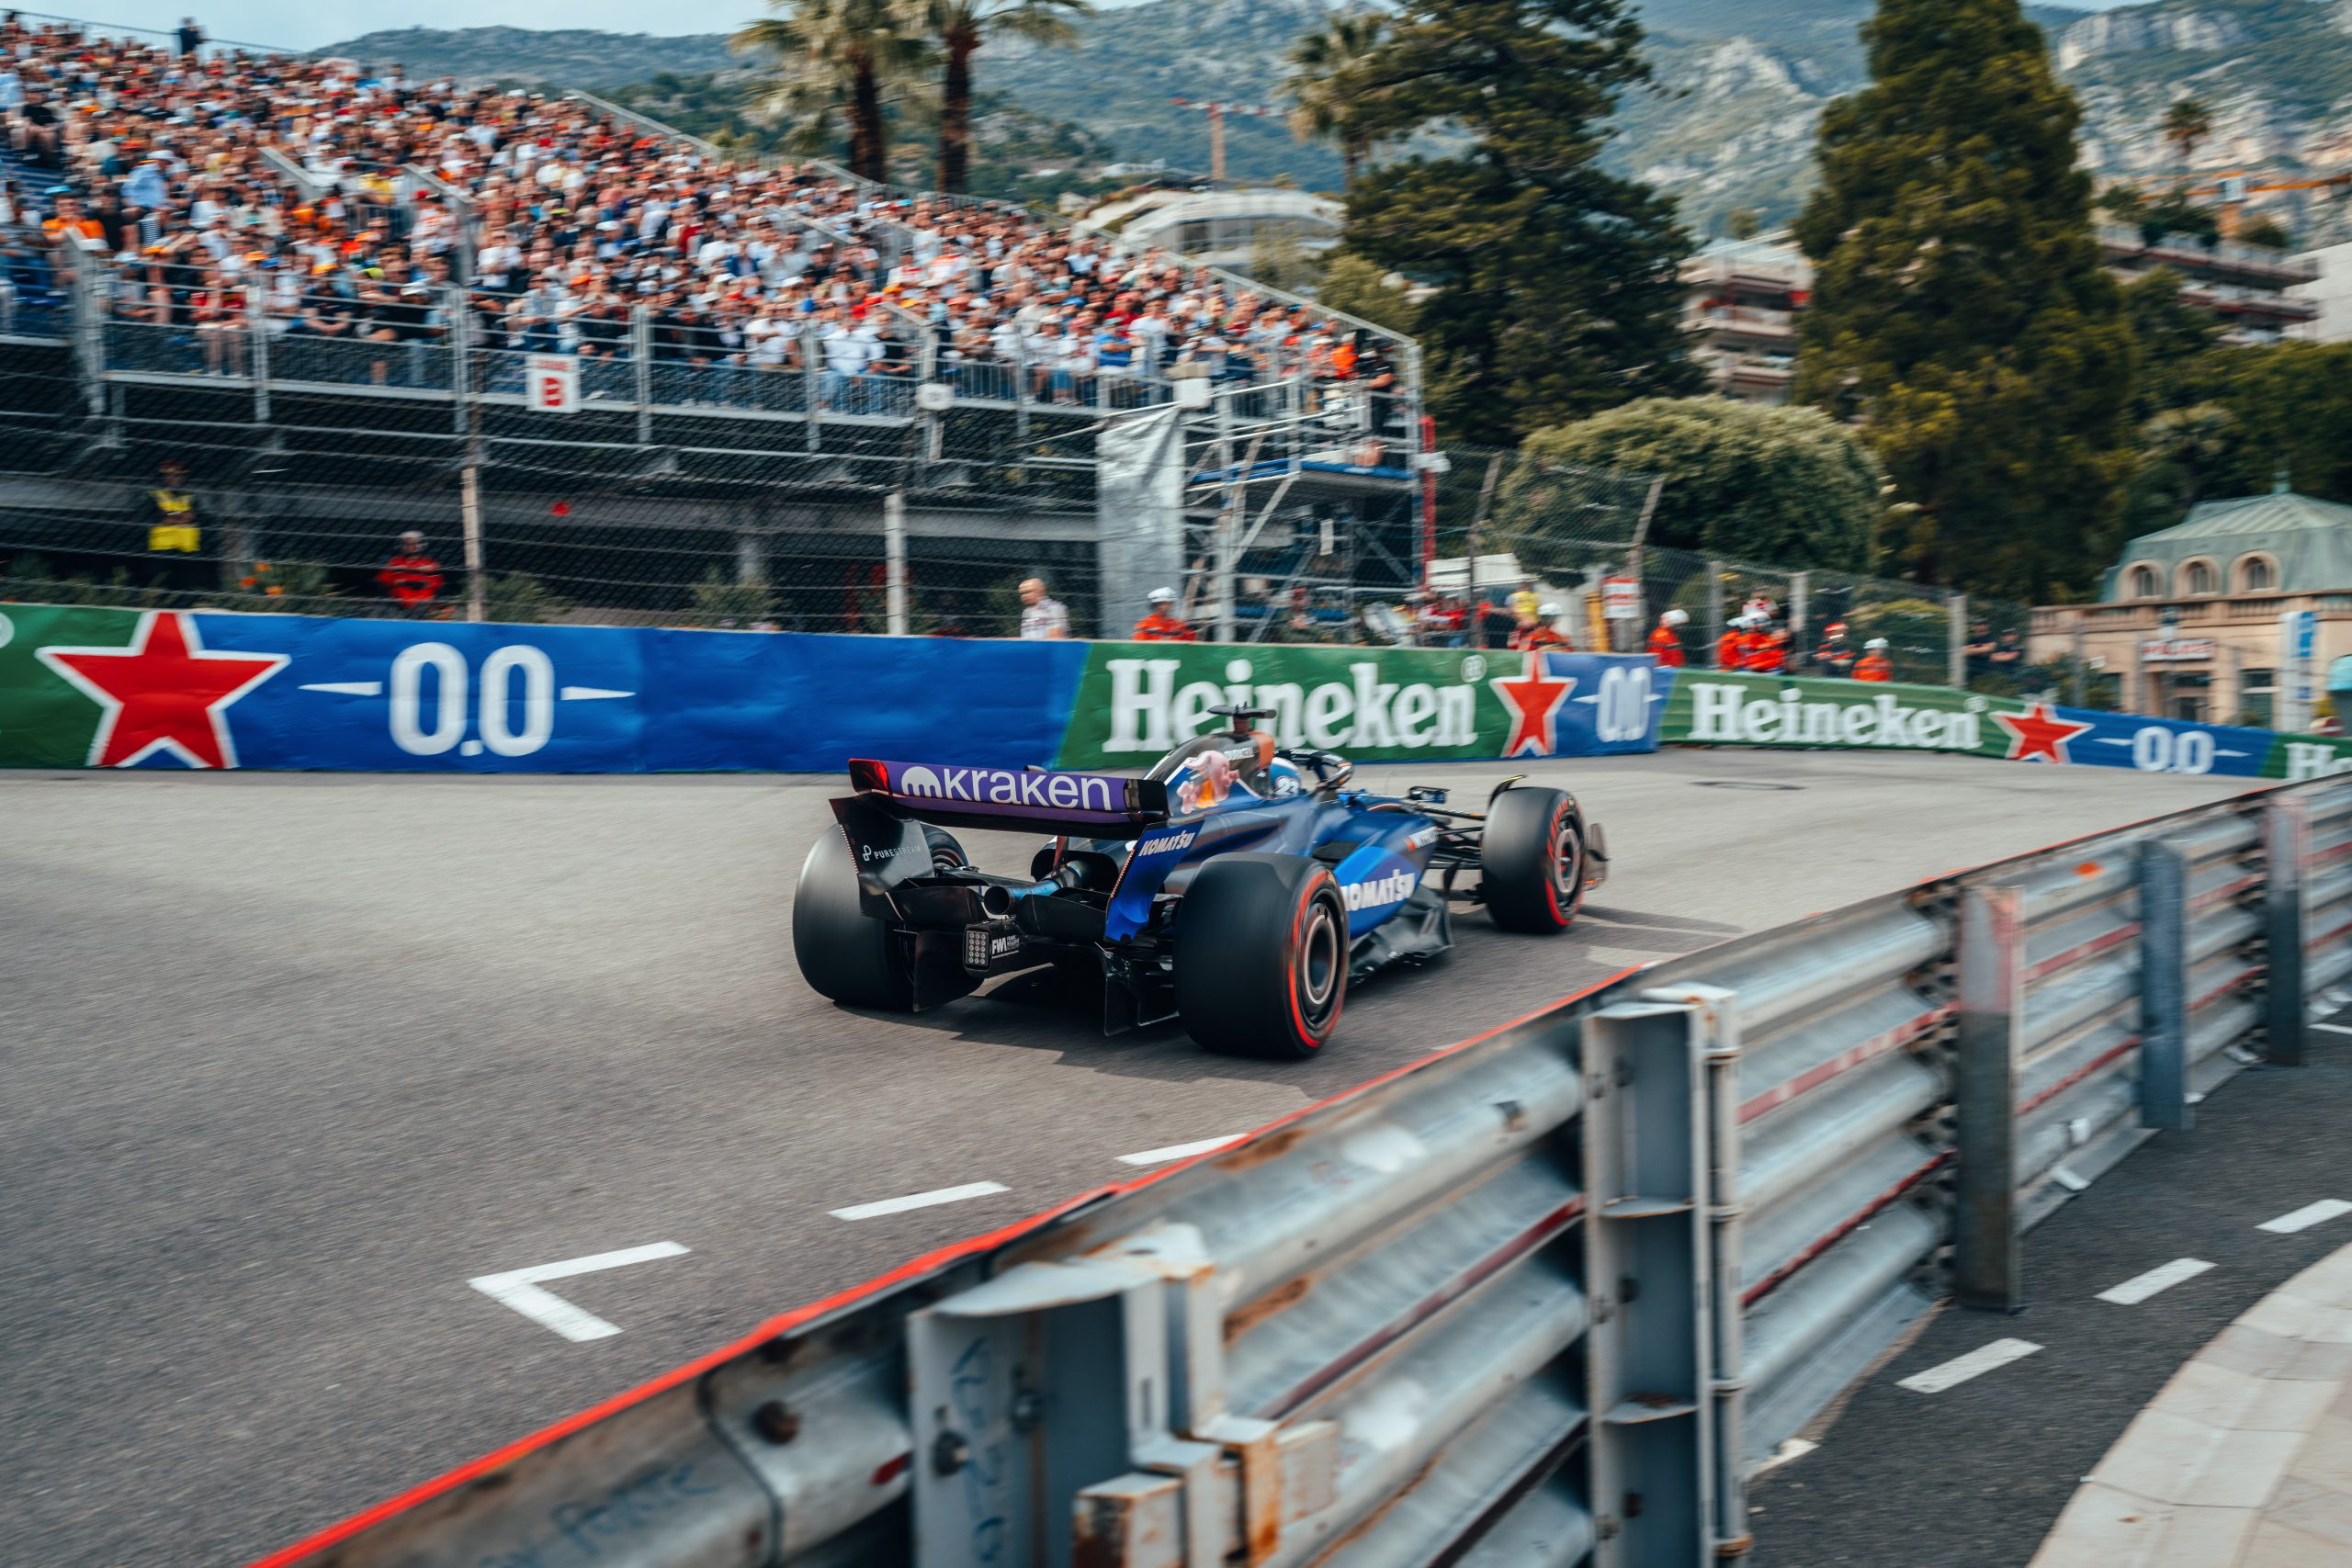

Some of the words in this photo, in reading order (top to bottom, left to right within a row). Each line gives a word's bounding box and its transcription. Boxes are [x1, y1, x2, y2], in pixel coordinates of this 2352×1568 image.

[390, 641, 555, 757] 0.0
[1102, 659, 1479, 753] Heineken
[1687, 683, 1984, 750] Heineken
[2132, 726, 2216, 774] 0.0
[944, 768, 1112, 811] kraken
[1274, 776, 1300, 795] 23
[874, 845, 922, 860] PURESTREAM
[1138, 830, 1195, 856] KOMATSU
